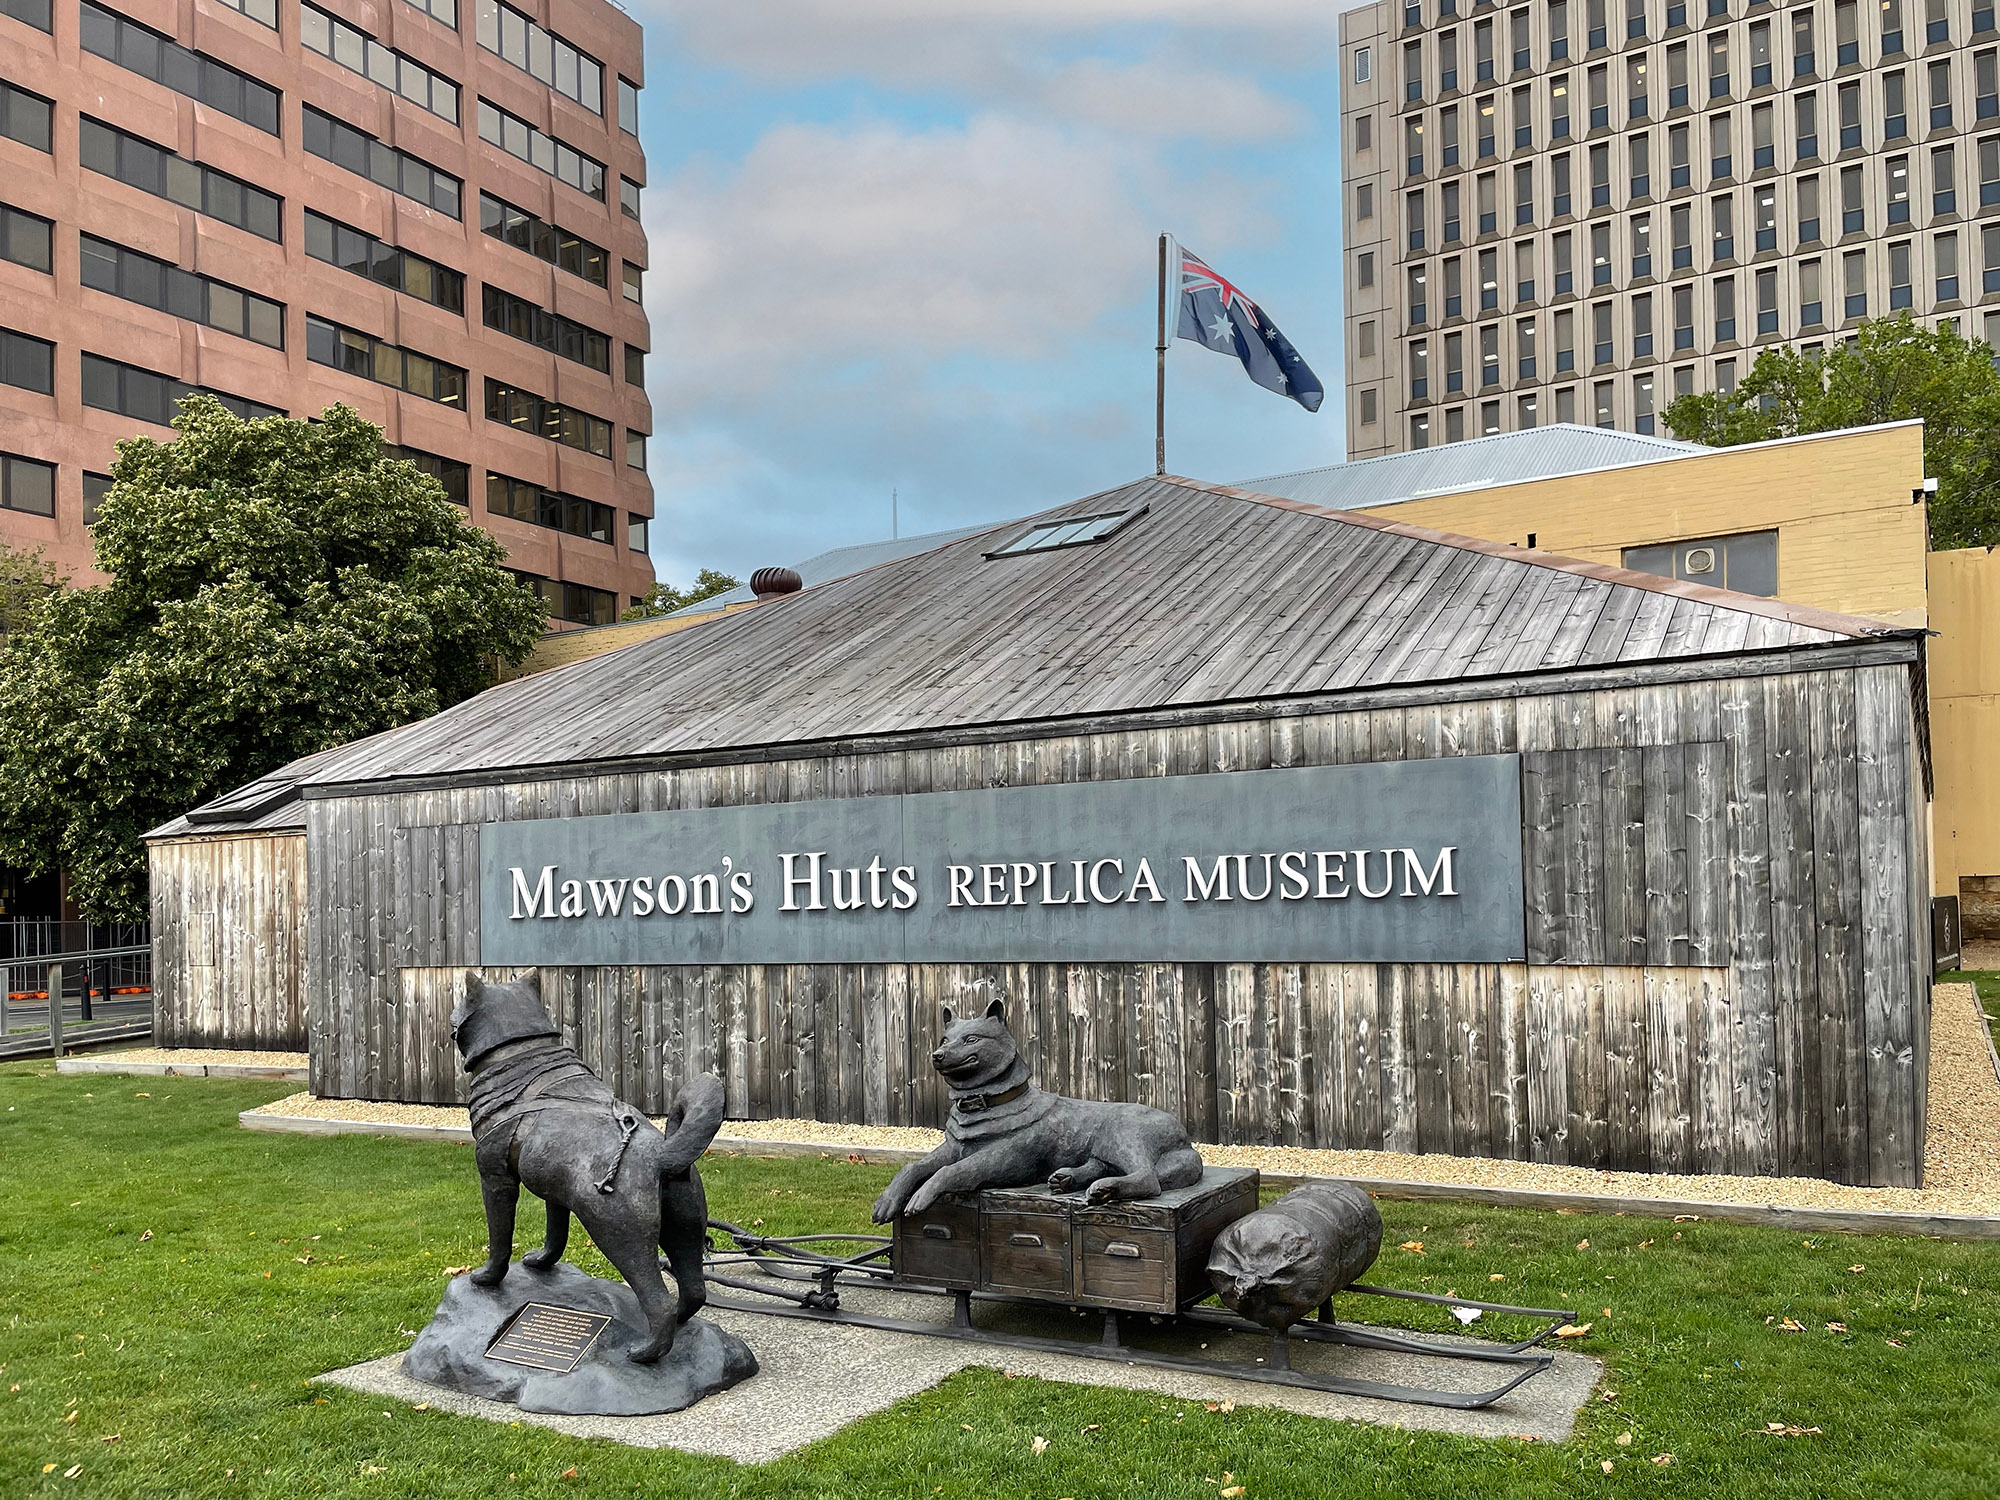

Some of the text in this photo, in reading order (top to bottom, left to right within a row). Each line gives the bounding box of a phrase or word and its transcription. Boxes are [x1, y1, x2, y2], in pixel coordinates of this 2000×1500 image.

[508, 846, 1459, 919] Mawson’s Huts REPLICA MUSEUM
